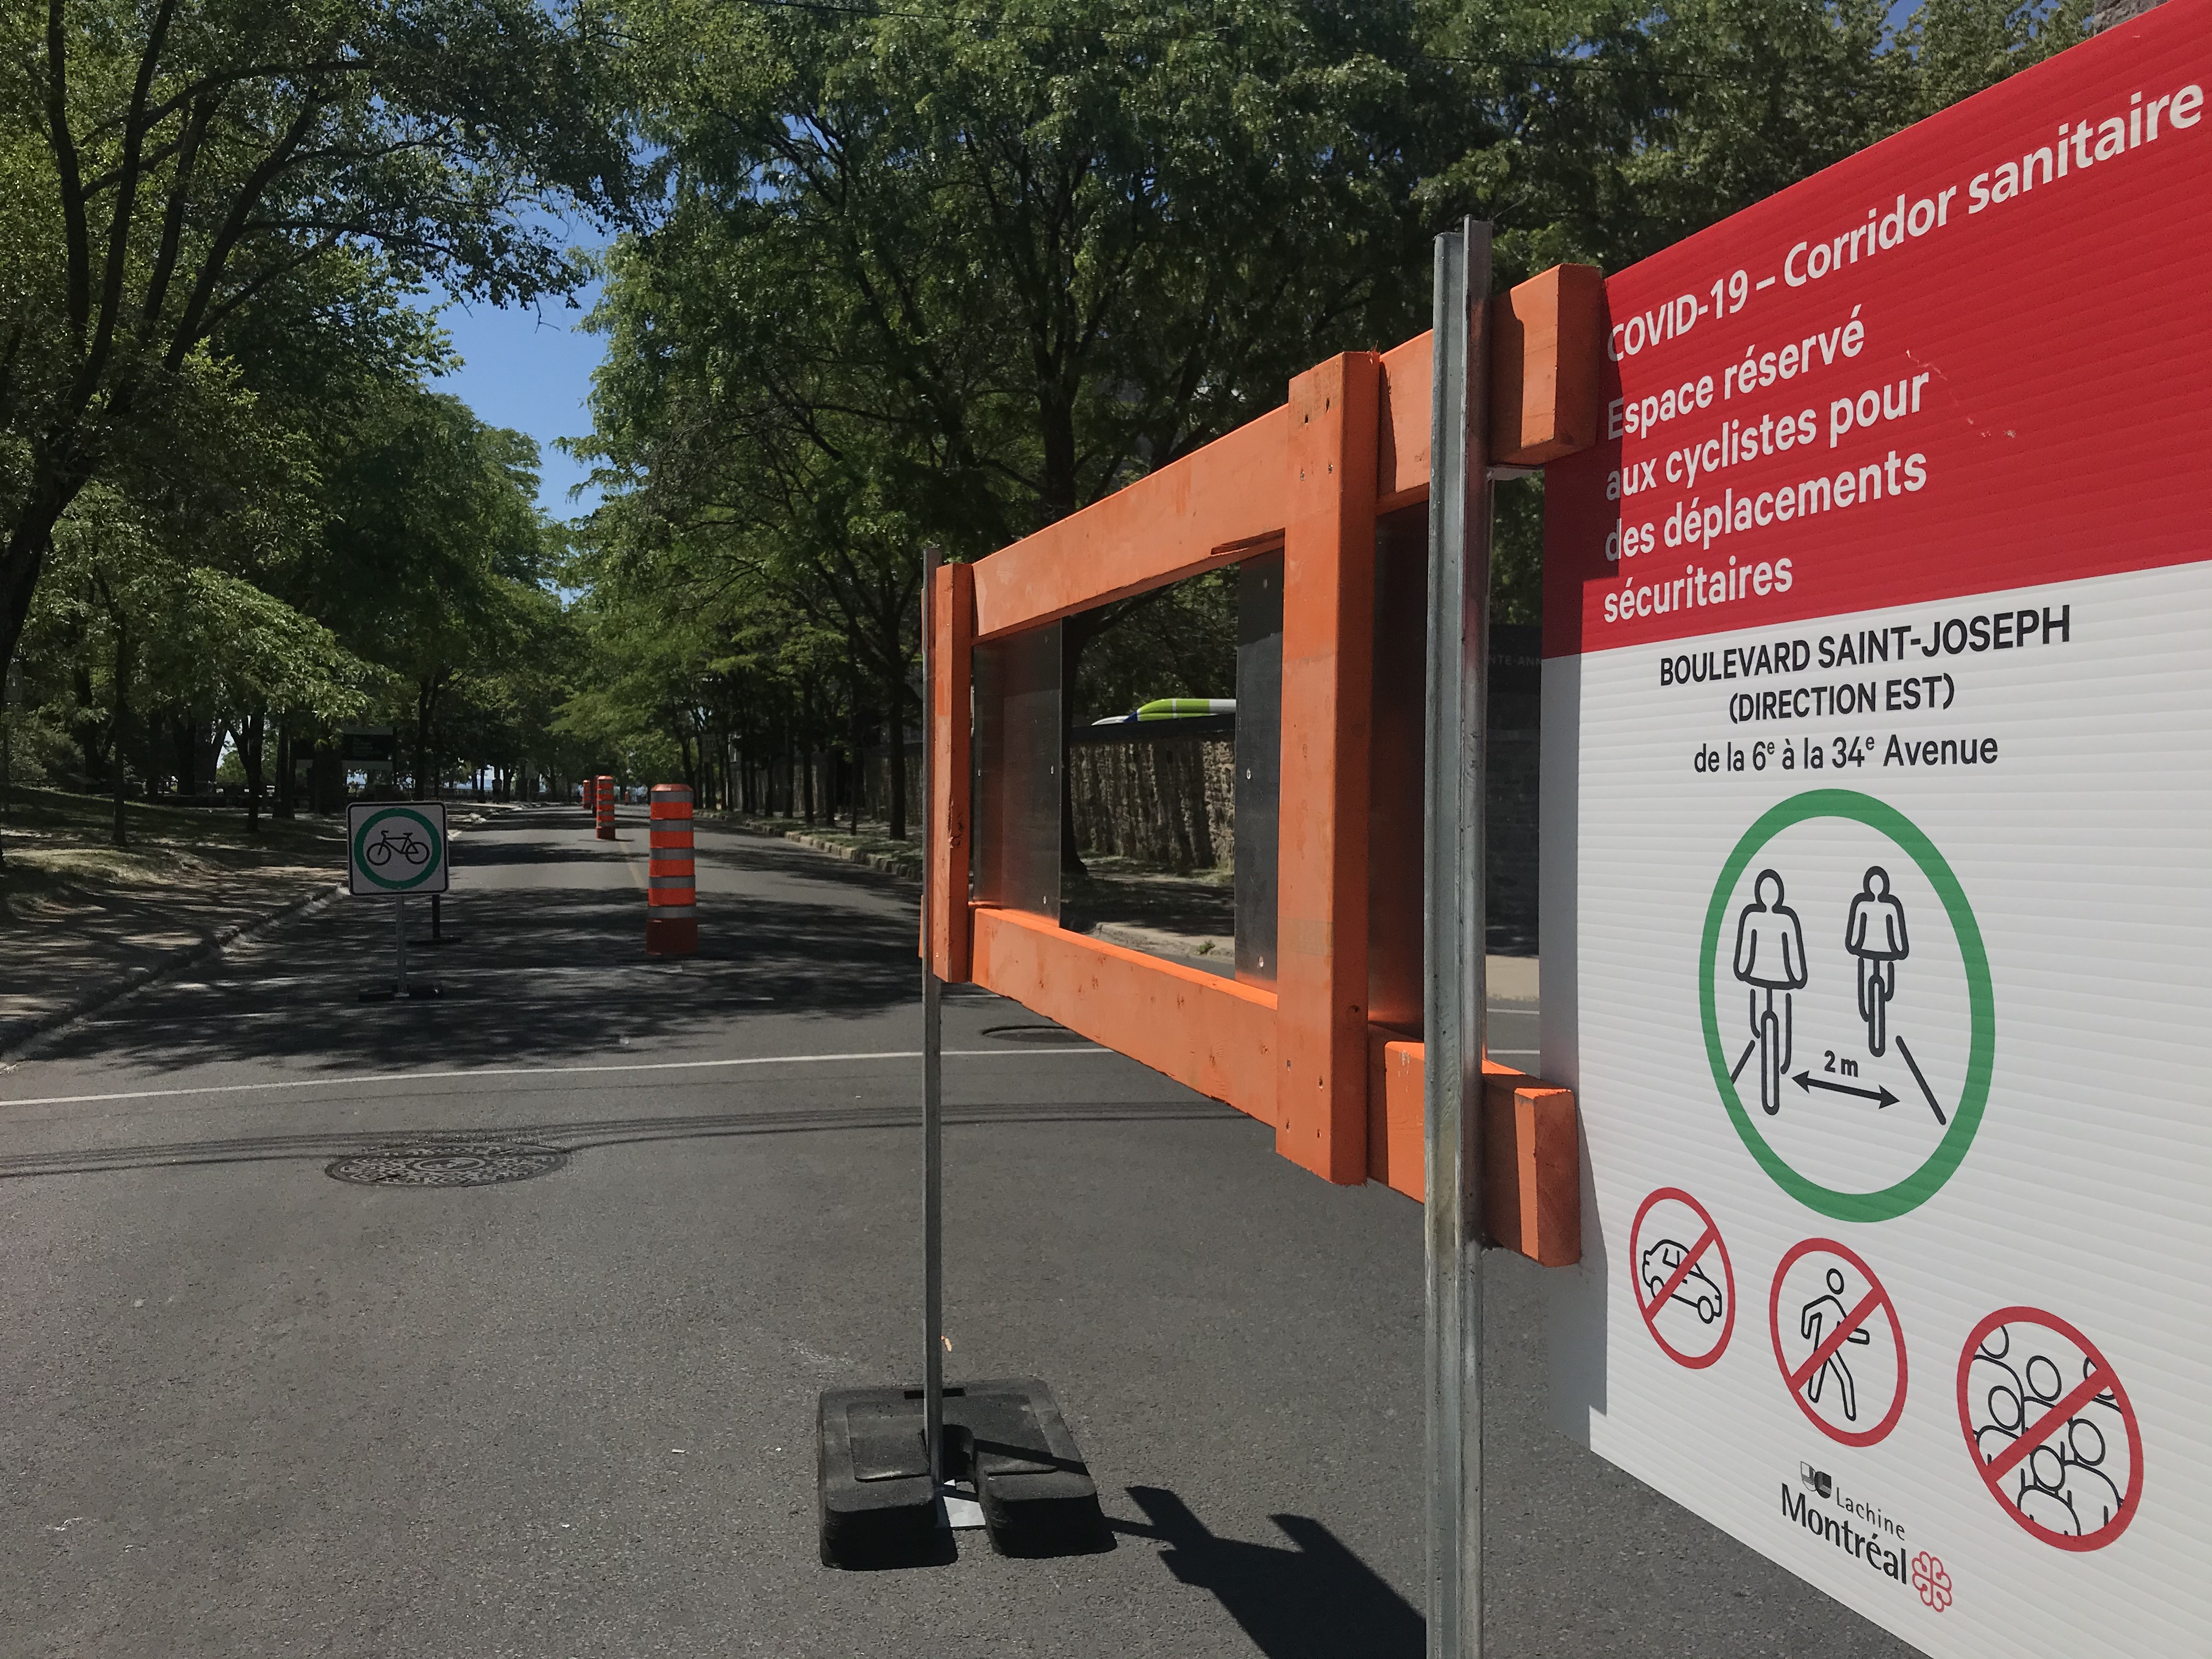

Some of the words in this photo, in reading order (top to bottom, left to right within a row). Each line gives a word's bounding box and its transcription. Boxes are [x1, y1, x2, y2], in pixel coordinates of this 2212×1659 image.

[1607, 269, 1748, 362] COVID-19
[1784, 185, 1957, 287] Corridor
[1968, 84, 2204, 214] sanitaire
[1608, 375, 1714, 440] Espace
[1724, 303, 1864, 400] réservé
[1606, 458, 1657, 501] aux
[1666, 409, 1816, 489] cyclistes
[1830, 371, 1929, 449] pour
[1605, 517, 1655, 562] des
[1664, 450, 1927, 550] déplacements
[1604, 555, 1792, 623] sécuritaires
[1661, 640, 1810, 686] BOULEVARD
[1818, 604, 2070, 669] SAINT-JOSEPH
[1729, 681, 1876, 724] (DIRECTION
[1886, 672, 1955, 711] EST)
[1694, 743, 1719, 773] de
[1727, 741, 1745, 771] la
[1782, 738, 1795, 770] à
[1804, 737, 1824, 769] la
[1883, 734, 1998, 766] Avenue
[1781, 1482, 1907, 1585] Montréal
[1836, 1487, 1905, 1541] Lachine
